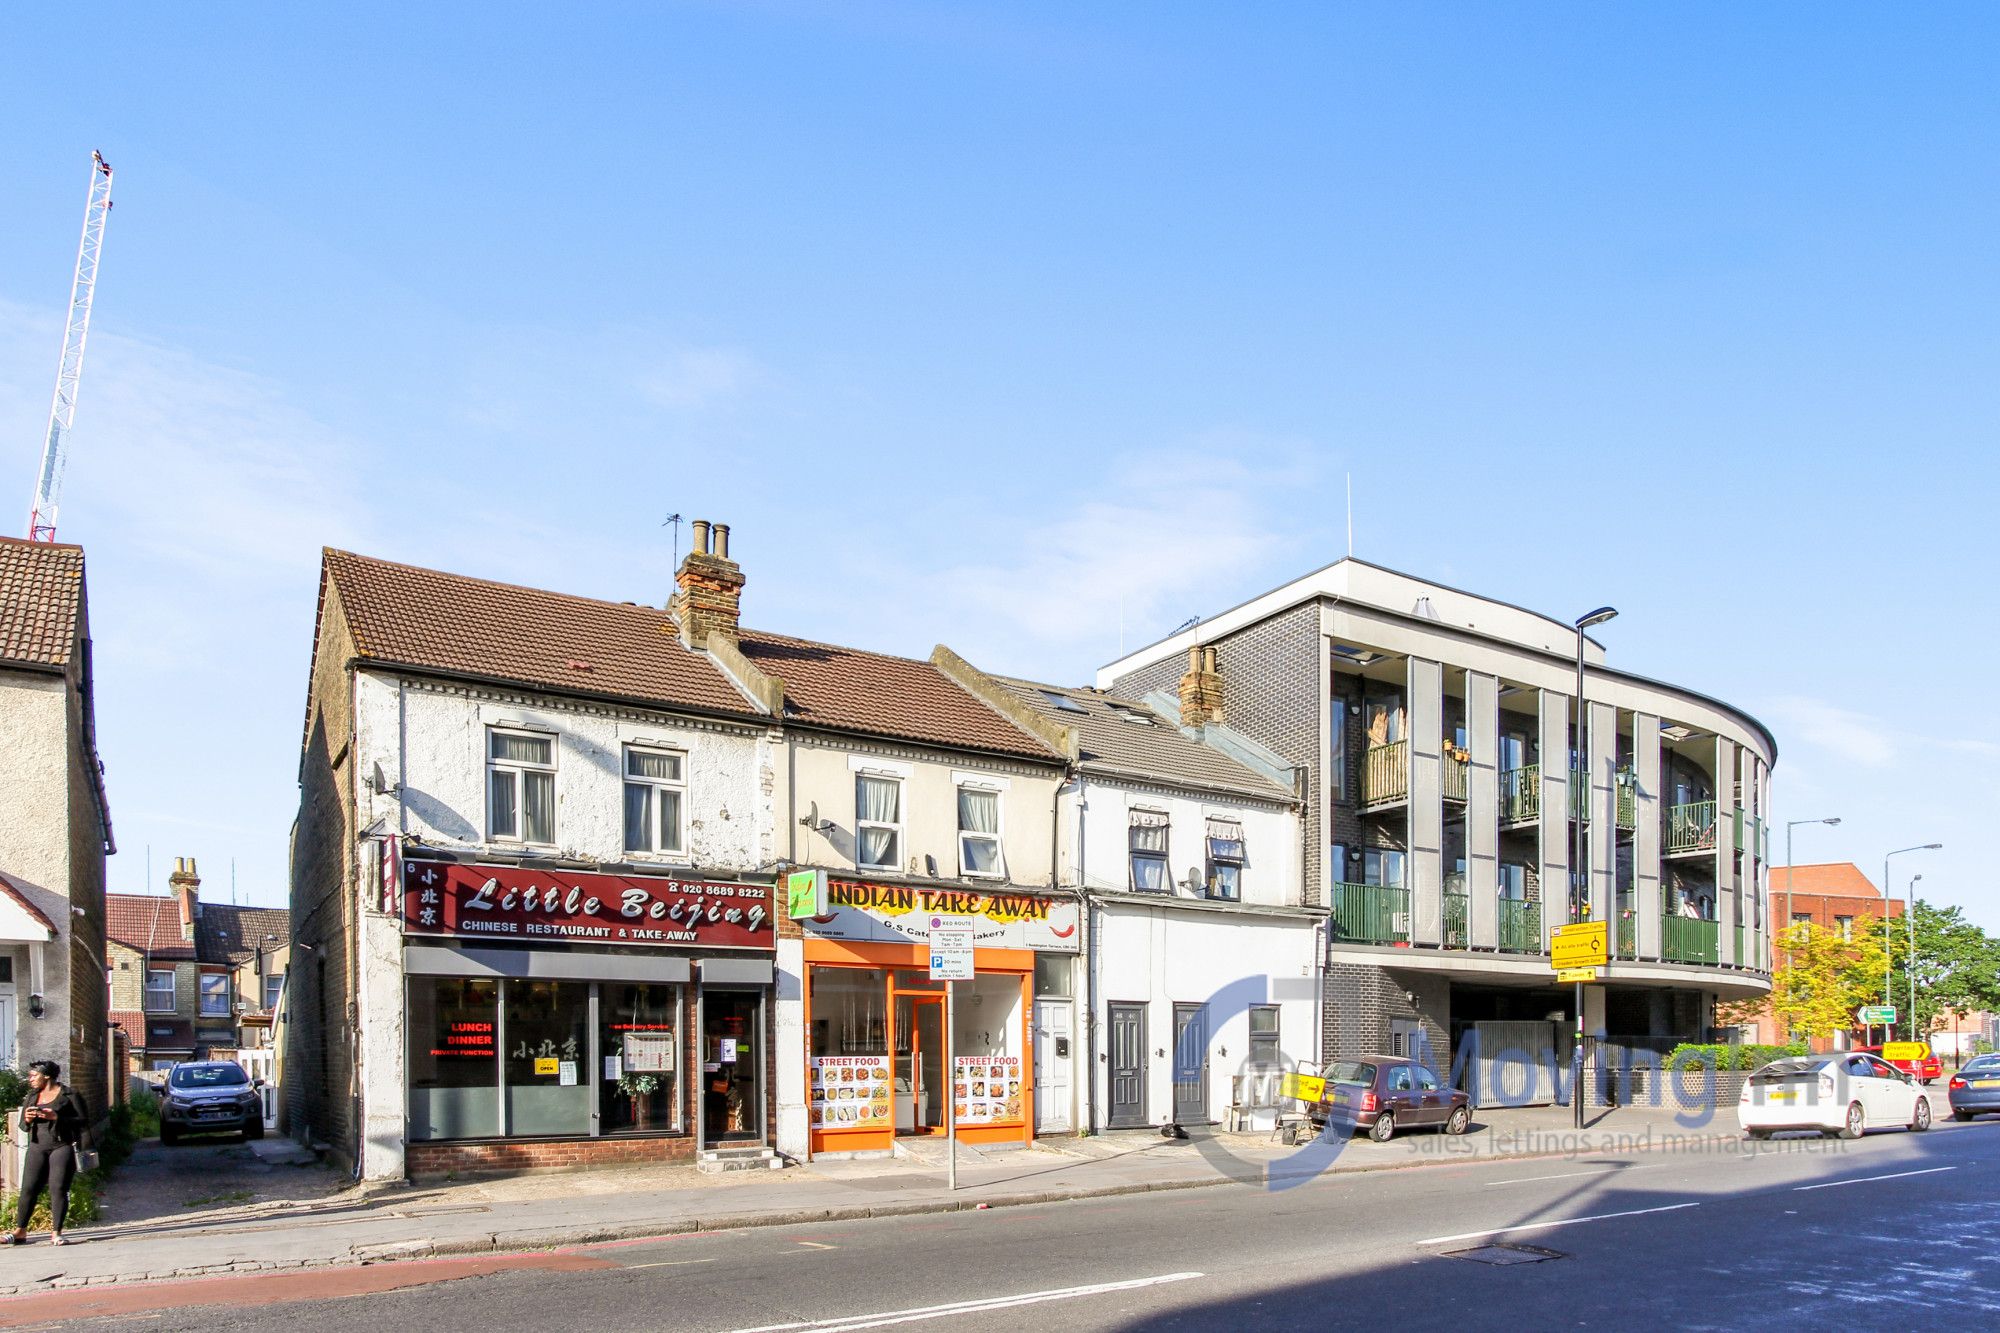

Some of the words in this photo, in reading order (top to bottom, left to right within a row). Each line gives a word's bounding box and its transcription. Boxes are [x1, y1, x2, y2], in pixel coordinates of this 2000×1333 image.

[407, 863, 416, 874] 6
[419, 868, 439, 926] 小北京
[682, 884, 702, 894] 020
[706, 886, 735, 896] 8689
[738, 888, 765, 899] 8222
[464, 877, 600, 915] Little
[621, 889, 766, 932] Beijing
[829, 883, 913, 910] INDIAN
[919, 891, 983, 914] TAKE
[984, 896, 1052, 920] AWAY
[462, 920, 518, 933] CHINESE
[526, 923, 611, 938] RESTAURANT
[618, 928, 628, 939] &
[631, 929, 697, 941] TAKE-AWAY
[451, 1023, 492, 1032] LUNCH
[447, 1035, 493, 1045] DINNER
[512, 1037, 580, 1060] 小北京
[818, 1057, 853, 1066] STREET
[854, 1057, 880, 1066] FOOD
[958, 1057, 992, 1066] STREET
[993, 1057, 1018, 1066] FOOD
